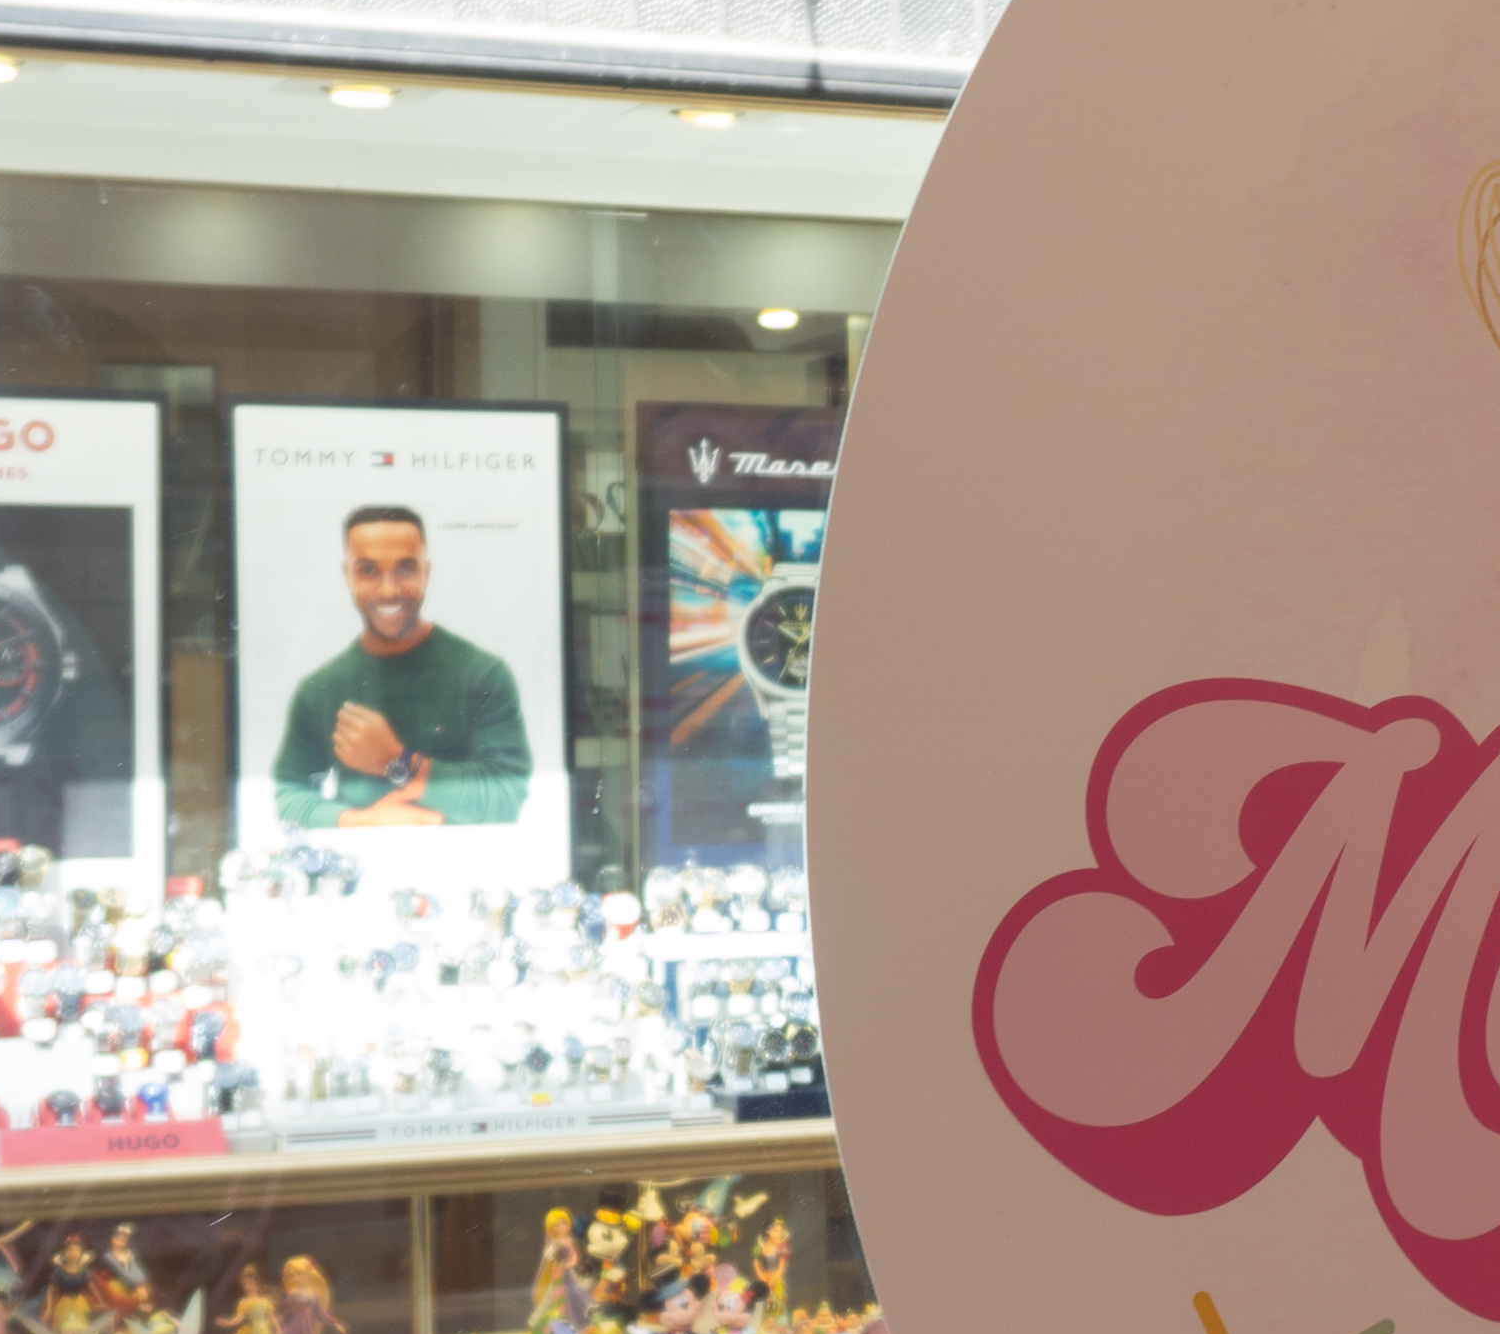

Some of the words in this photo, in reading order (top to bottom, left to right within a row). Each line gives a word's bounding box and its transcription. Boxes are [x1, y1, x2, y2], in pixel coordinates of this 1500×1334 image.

[255, 449, 355, 468] TOMMY
[411, 452, 535, 469] HILFIGER
[728, 451, 836, 476] Mase
[389, 1123, 464, 1139] TOMMY
[493, 1116, 577, 1132] HILFIGER
[107, 1133, 180, 1152] HUGO
